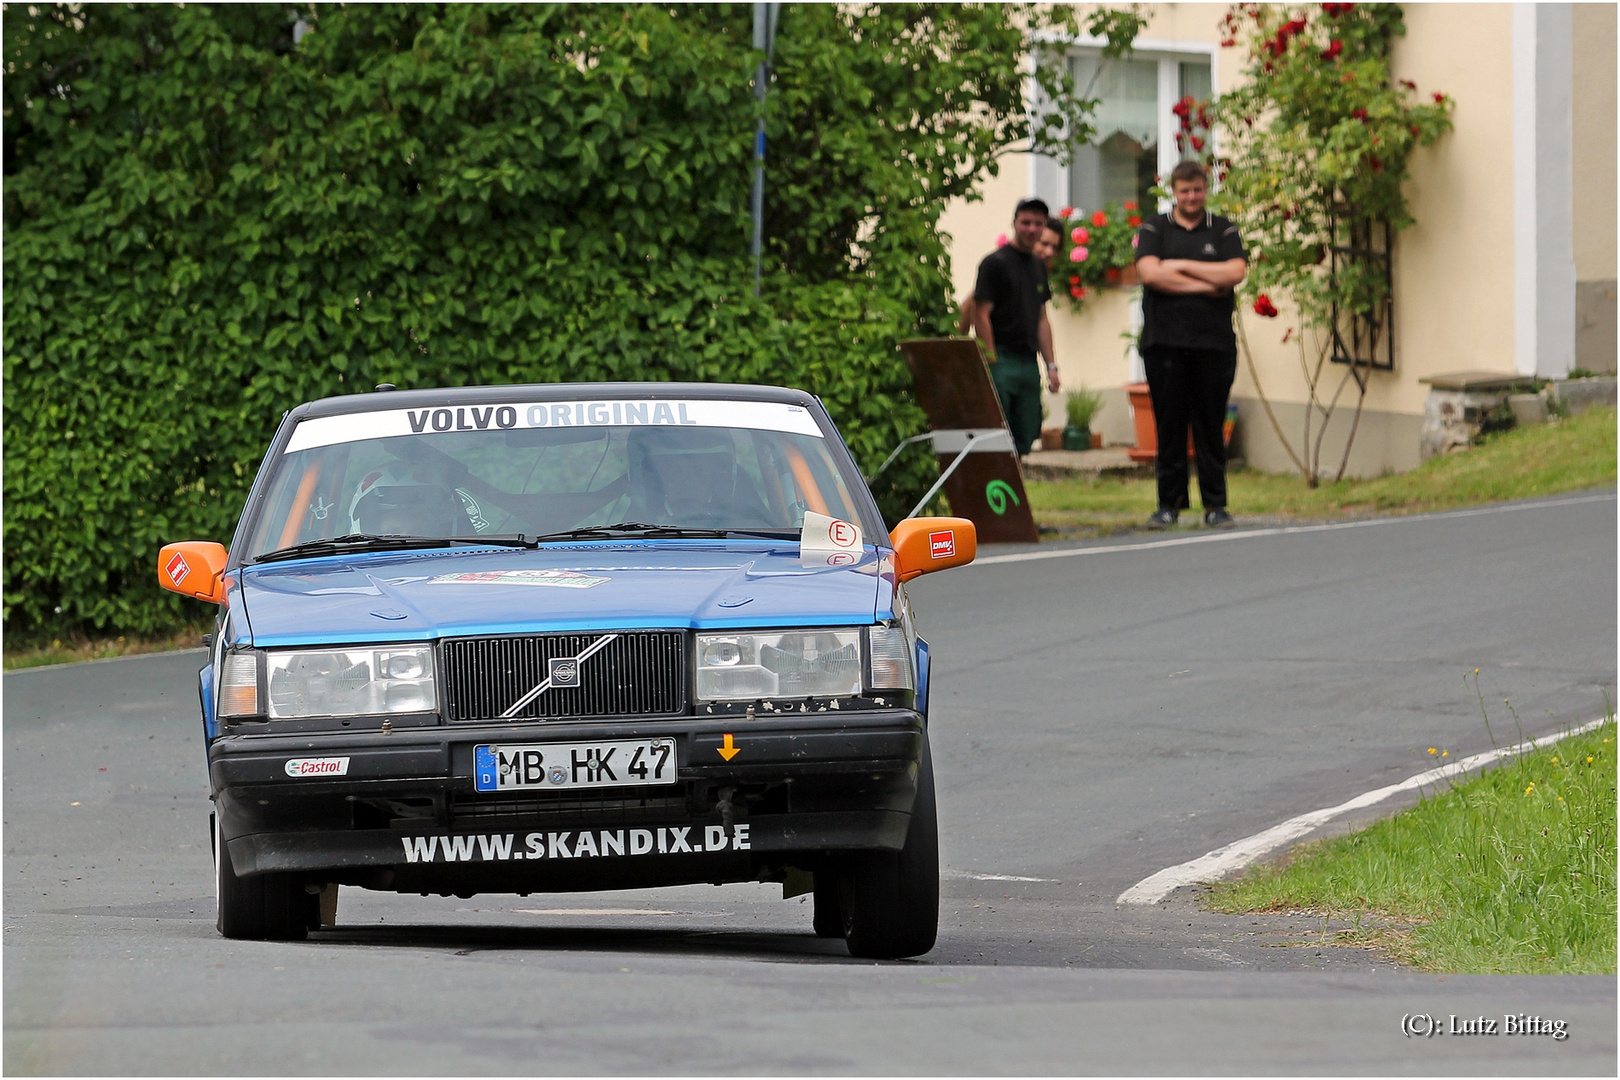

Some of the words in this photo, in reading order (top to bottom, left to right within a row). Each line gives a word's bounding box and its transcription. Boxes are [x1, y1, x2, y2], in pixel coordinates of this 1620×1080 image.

[407, 406, 517, 433] VOLVO
[526, 402, 697, 427] ORIGINAL
[835, 524, 848, 541] E
[932, 541, 952, 550] DMV
[301, 761, 341, 775] Castrol
[482, 773, 492, 784] D
[499, 750, 546, 785] MB
[570, 747, 618, 783] HK
[628, 744, 671, 780] 47
[401, 823, 751, 864] WWW.SKANDIX.DE
